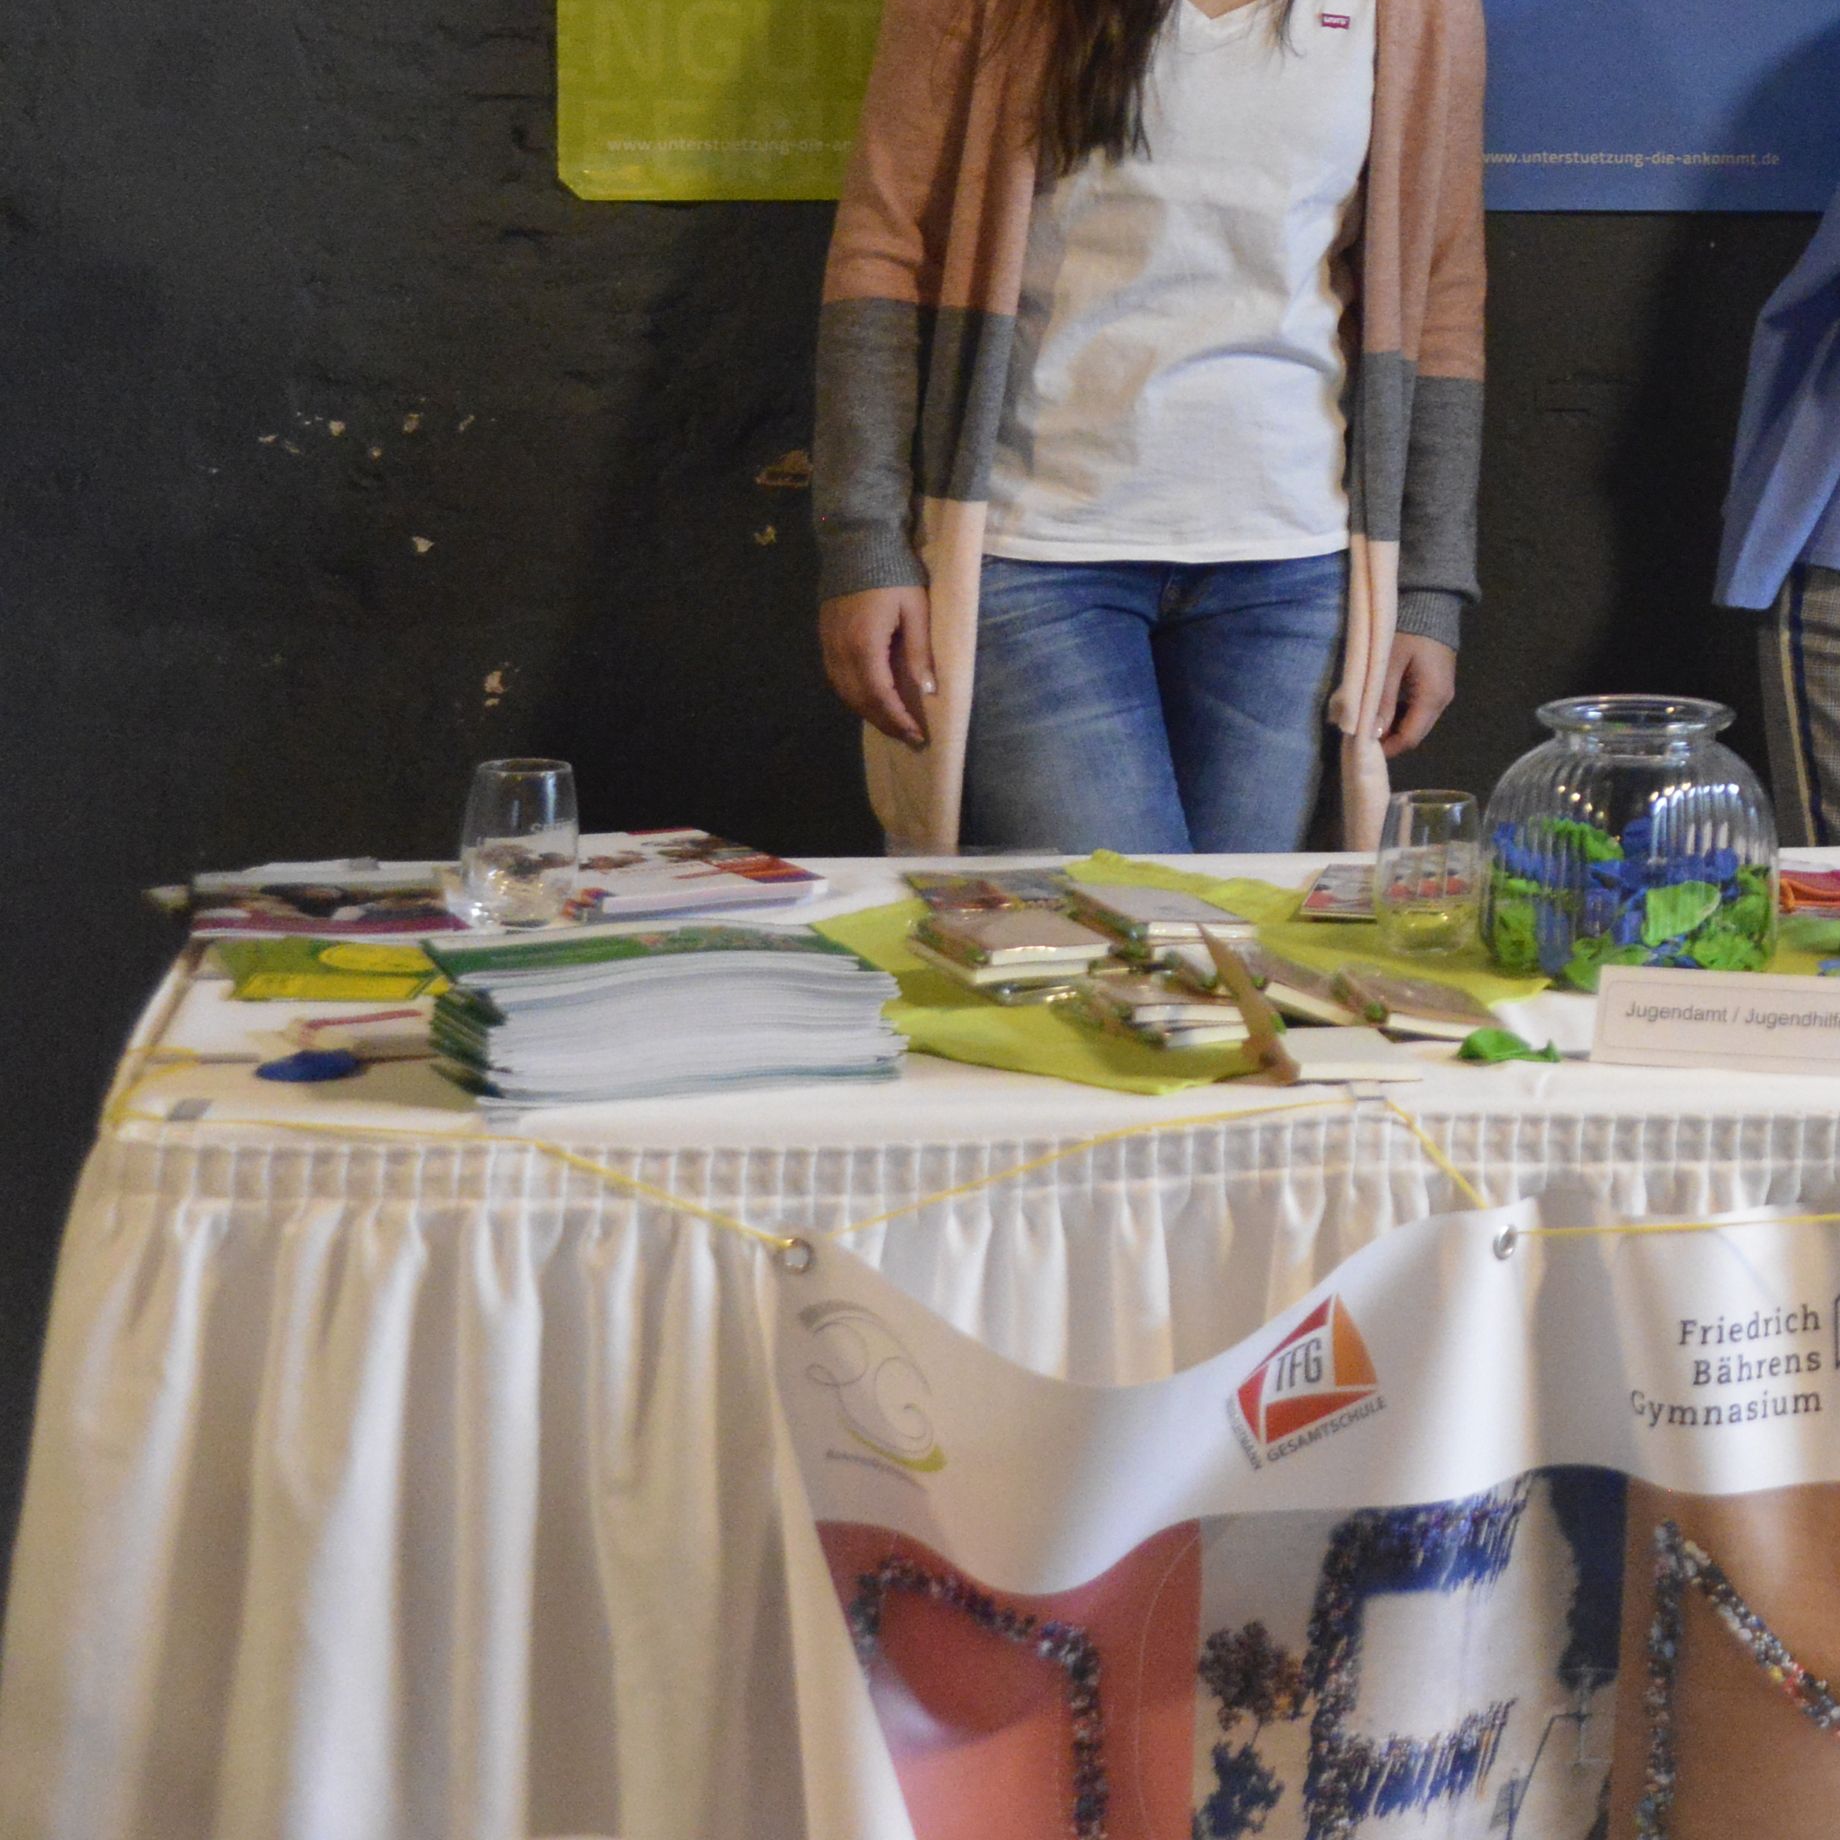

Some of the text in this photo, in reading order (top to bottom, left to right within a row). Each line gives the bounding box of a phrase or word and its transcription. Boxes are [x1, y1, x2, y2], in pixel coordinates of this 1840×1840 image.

[1625, 1001, 1727, 1022] Jugendamt
[1733, 1006, 1739, 1023] /
[1680, 1304, 1821, 1346] Friedrich
[1276, 1337, 1322, 1392] TFG
[1692, 1349, 1822, 1386] Bährens
[1267, 1396, 1386, 1462] GESAMTSCHULE
[1631, 1390, 1822, 1428] Gymnasium
